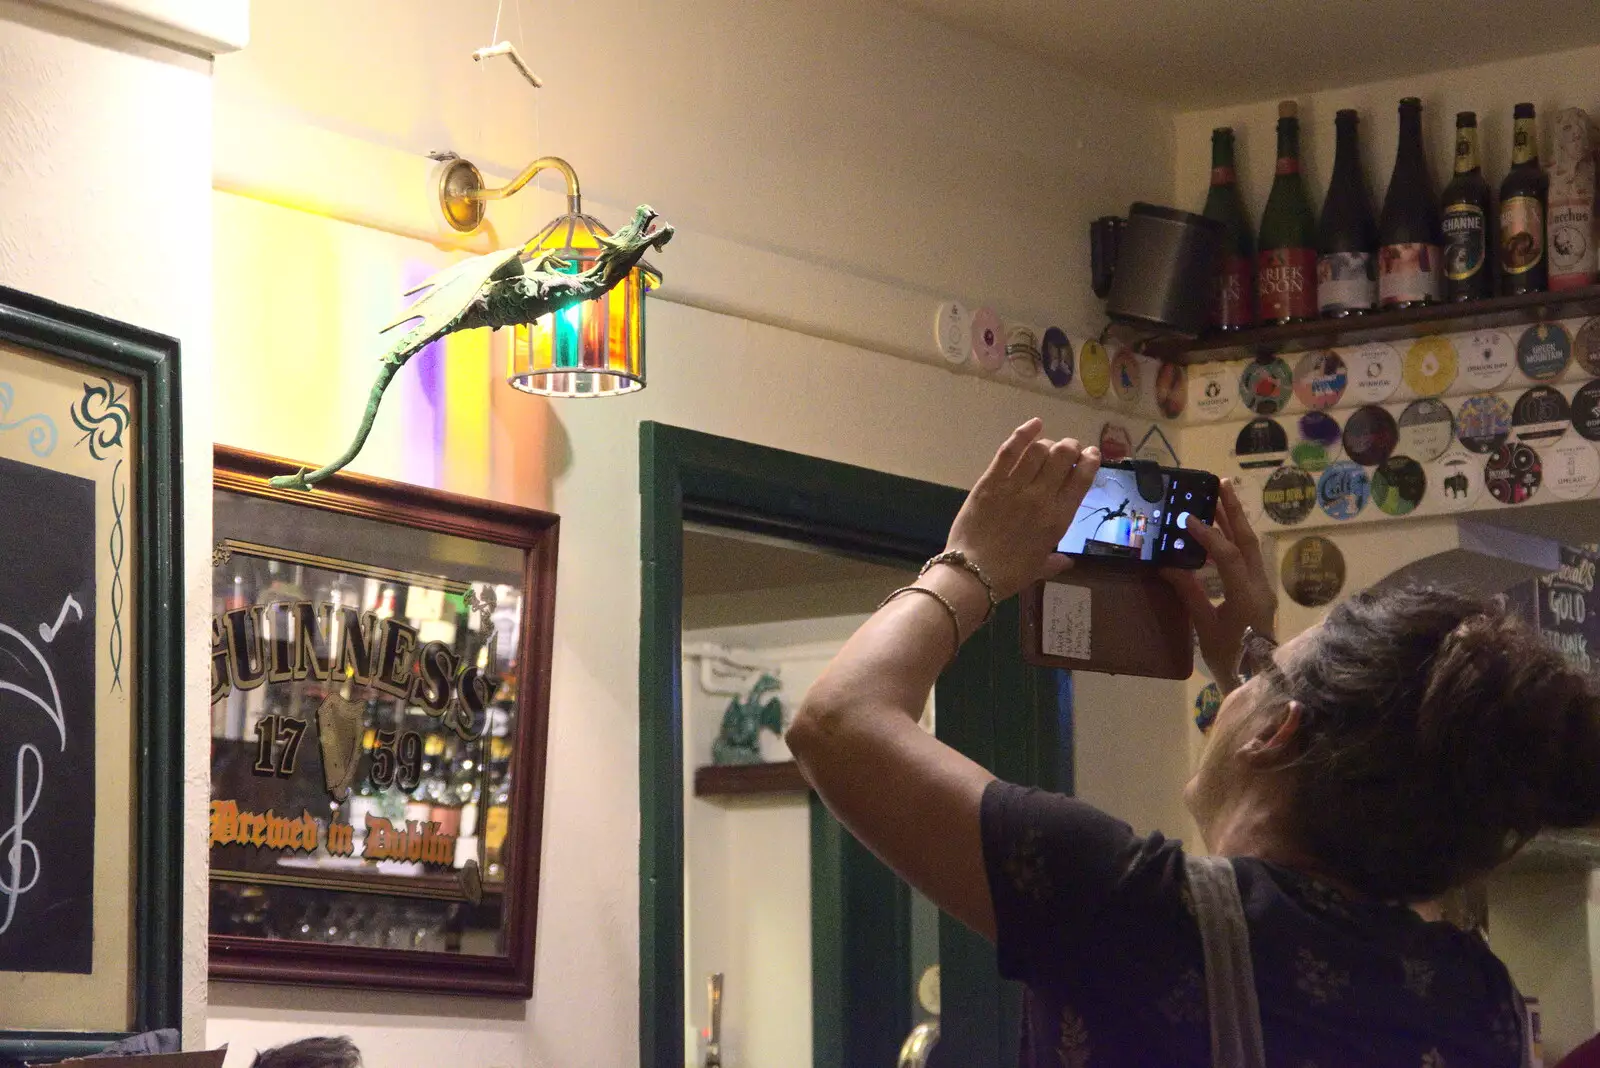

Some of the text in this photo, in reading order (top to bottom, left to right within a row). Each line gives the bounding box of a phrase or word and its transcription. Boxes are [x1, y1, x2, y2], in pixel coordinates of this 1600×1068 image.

[1525, 350, 1563, 364] MOUNTAIN
[1549, 589, 1586, 625] GOLD
[252, 714, 424, 795] 17 59
[209, 799, 456, 866] Brewed in Dublin
